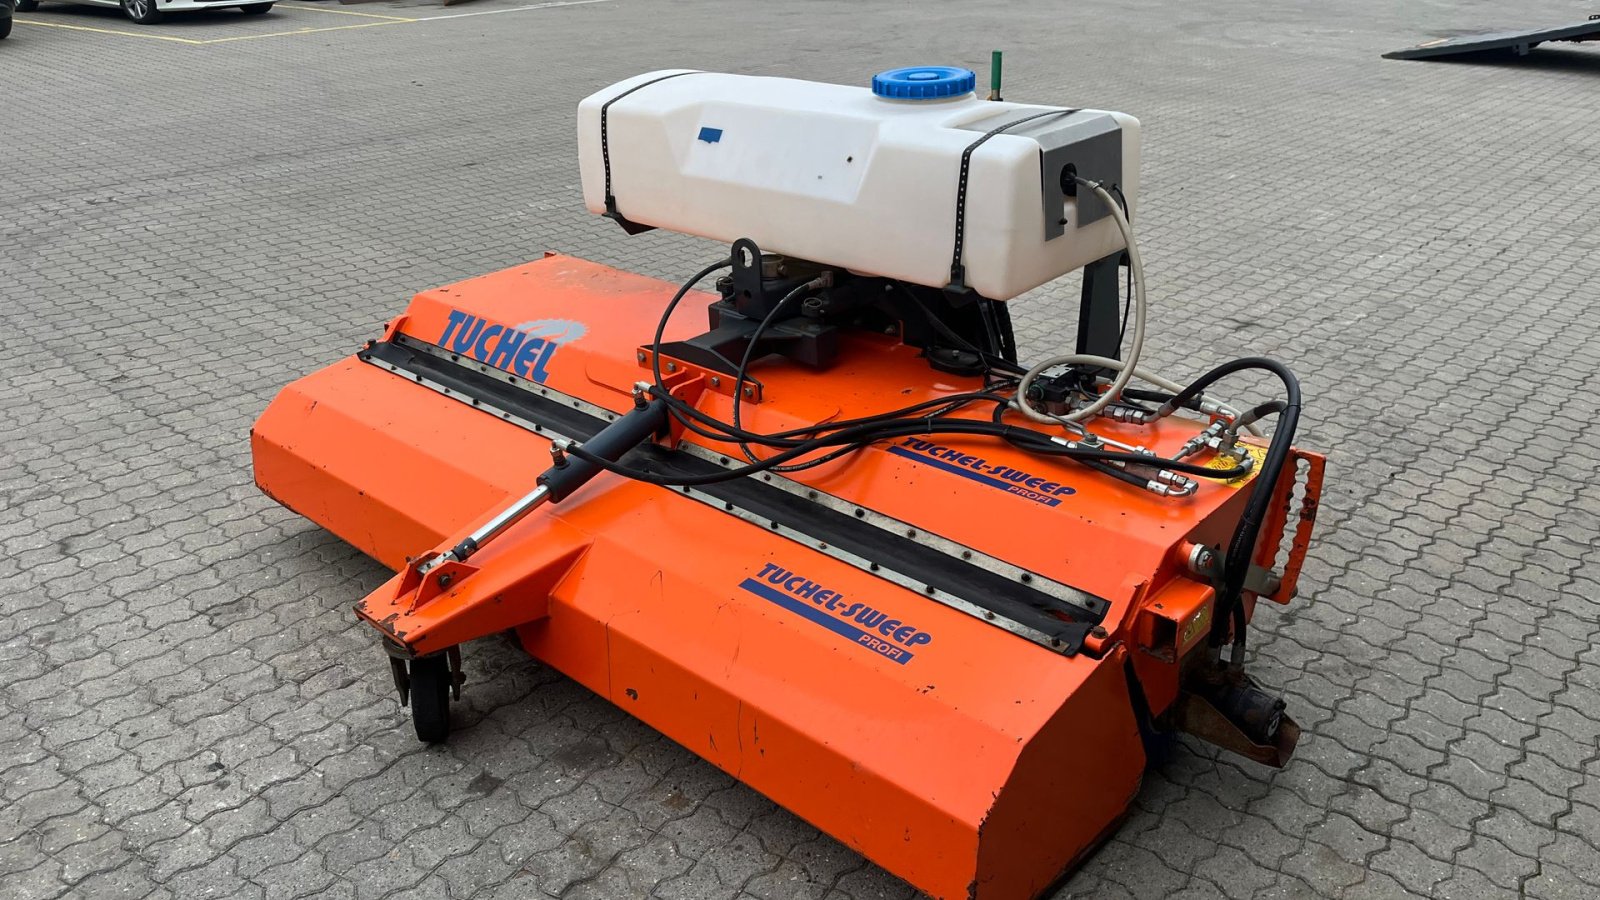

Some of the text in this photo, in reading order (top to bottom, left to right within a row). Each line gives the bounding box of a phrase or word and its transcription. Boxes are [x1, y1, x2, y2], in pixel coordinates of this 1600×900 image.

[438, 310, 558, 383] TUCHEL
[901, 437, 1076, 496] TUCHEL-SWEEP
[1007, 486, 1051, 504] PROFI
[756, 562, 932, 647] TUCHEL-SWEEP
[858, 634, 904, 660] PROFI
